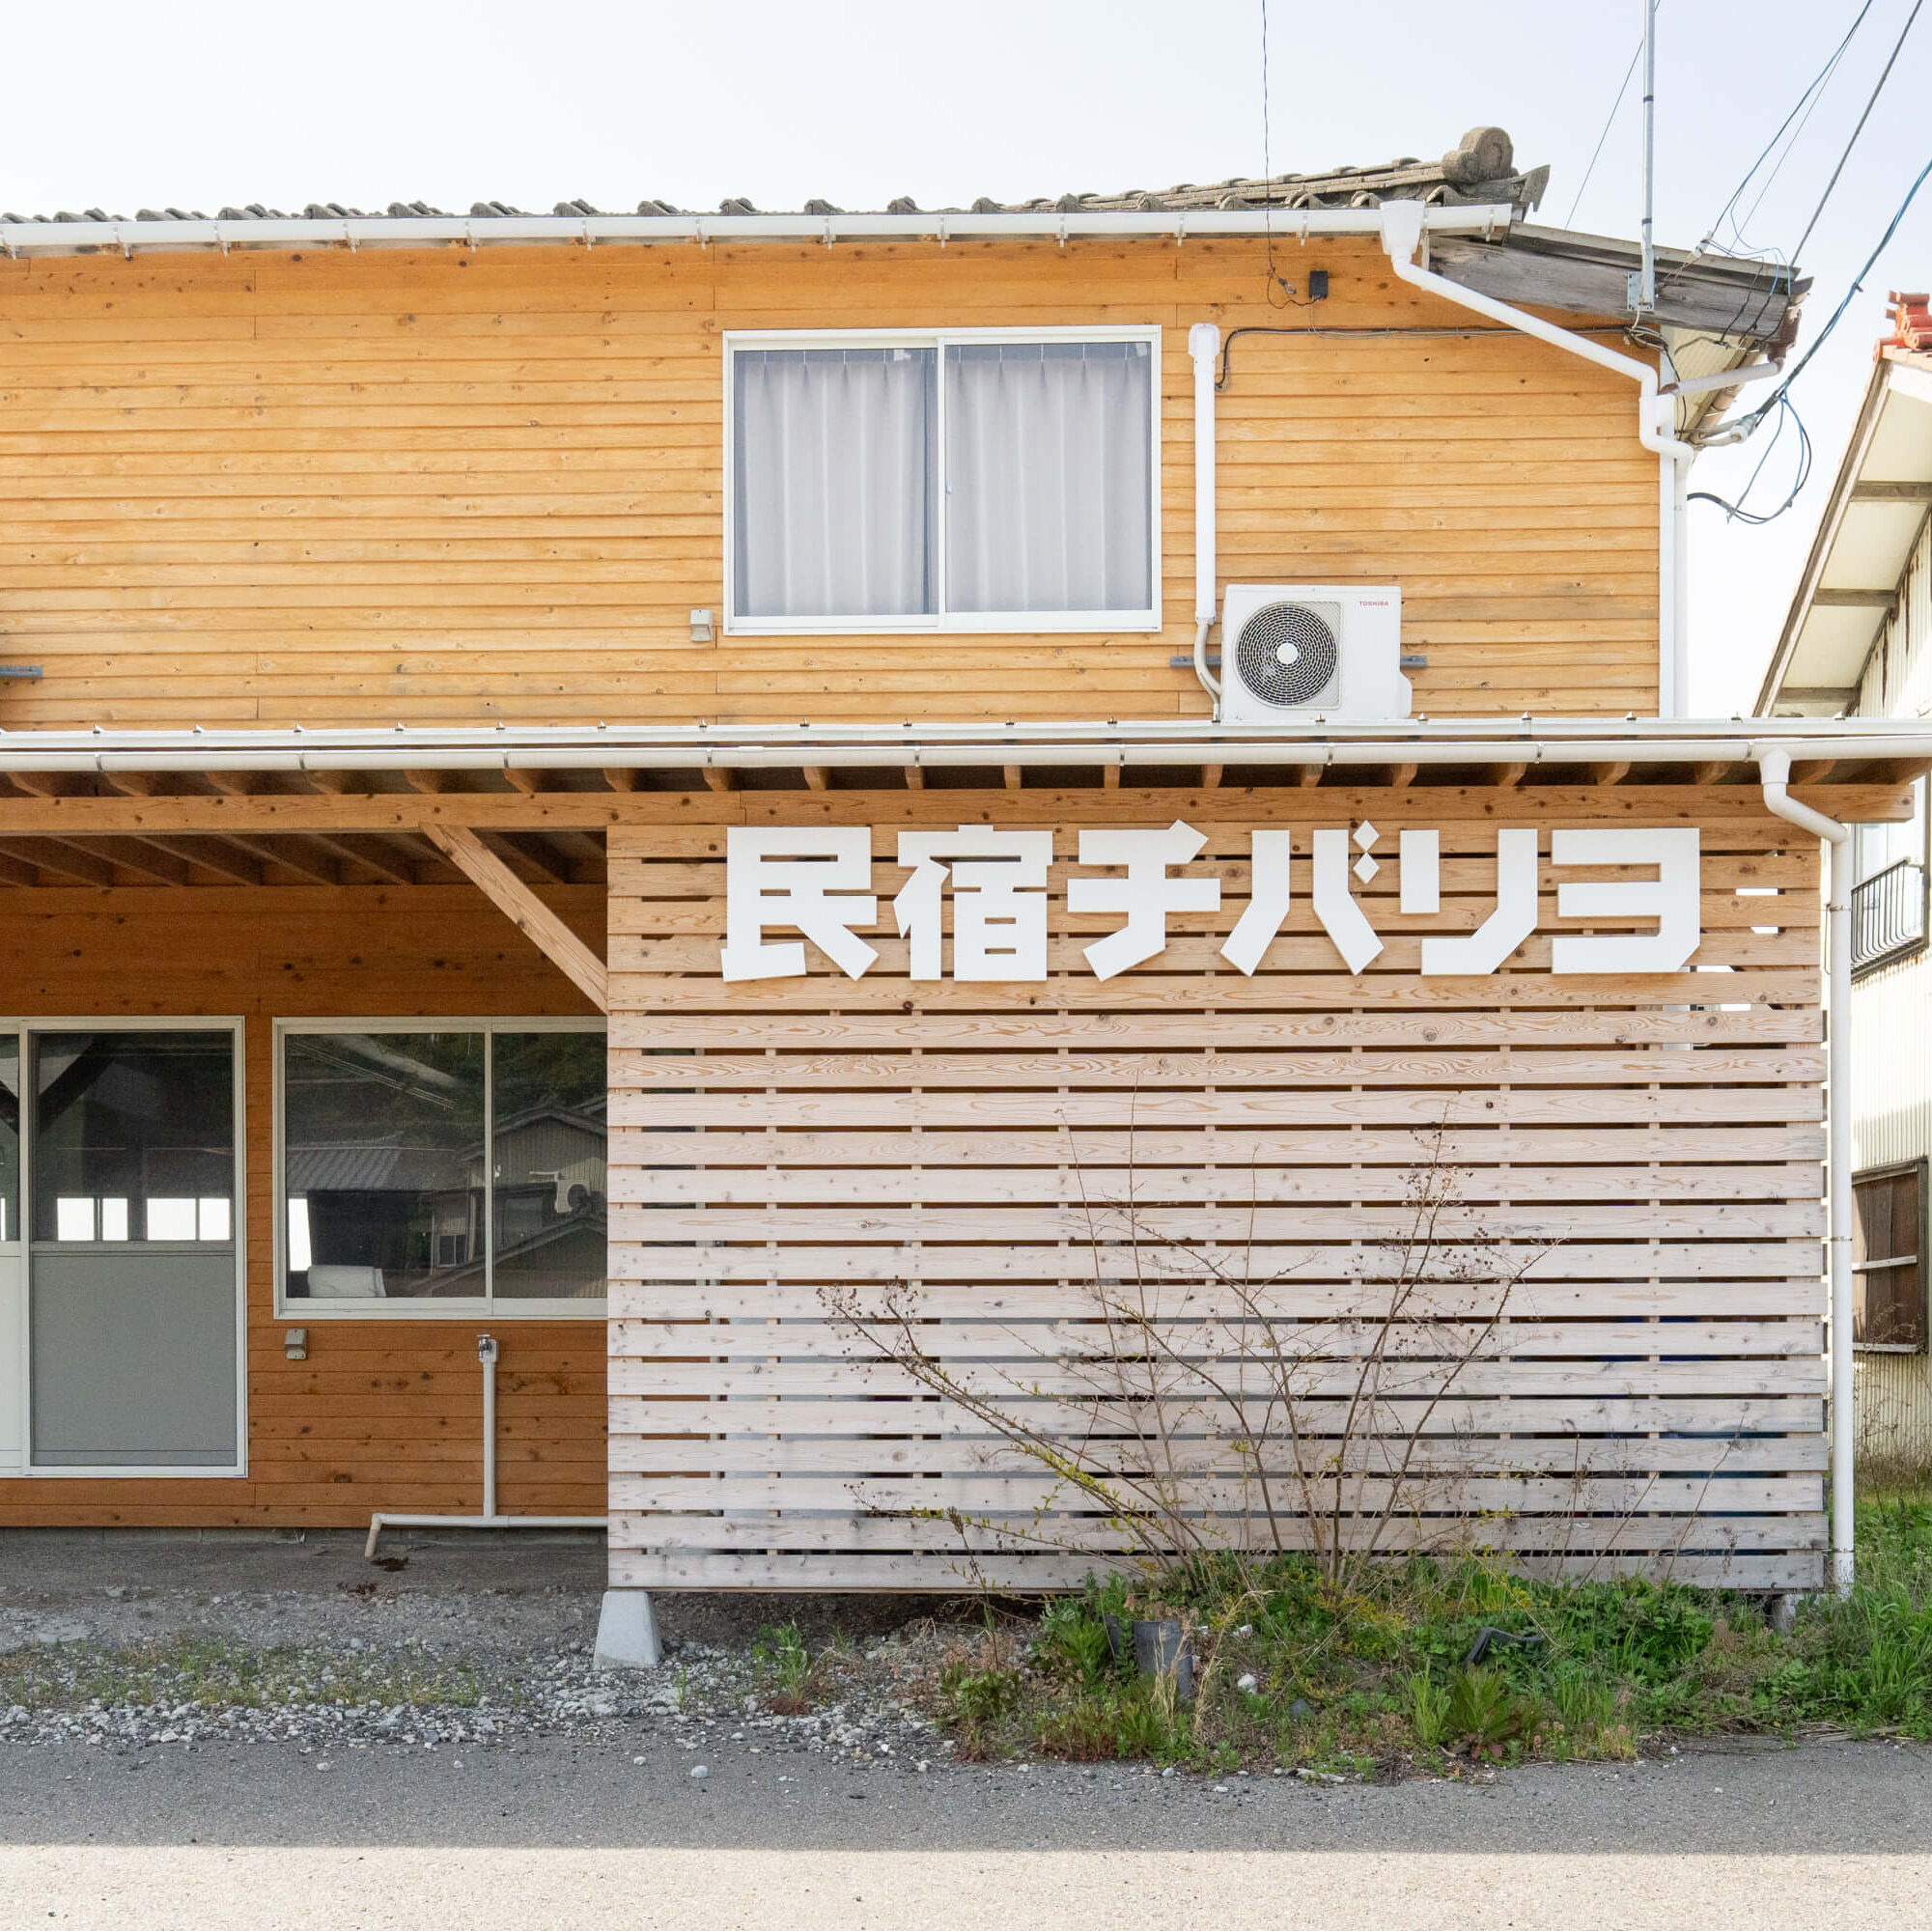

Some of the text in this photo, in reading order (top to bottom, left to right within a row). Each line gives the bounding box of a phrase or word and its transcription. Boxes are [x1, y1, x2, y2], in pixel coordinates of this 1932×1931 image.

[721, 820, 1700, 981] 民宿チバリヨ
